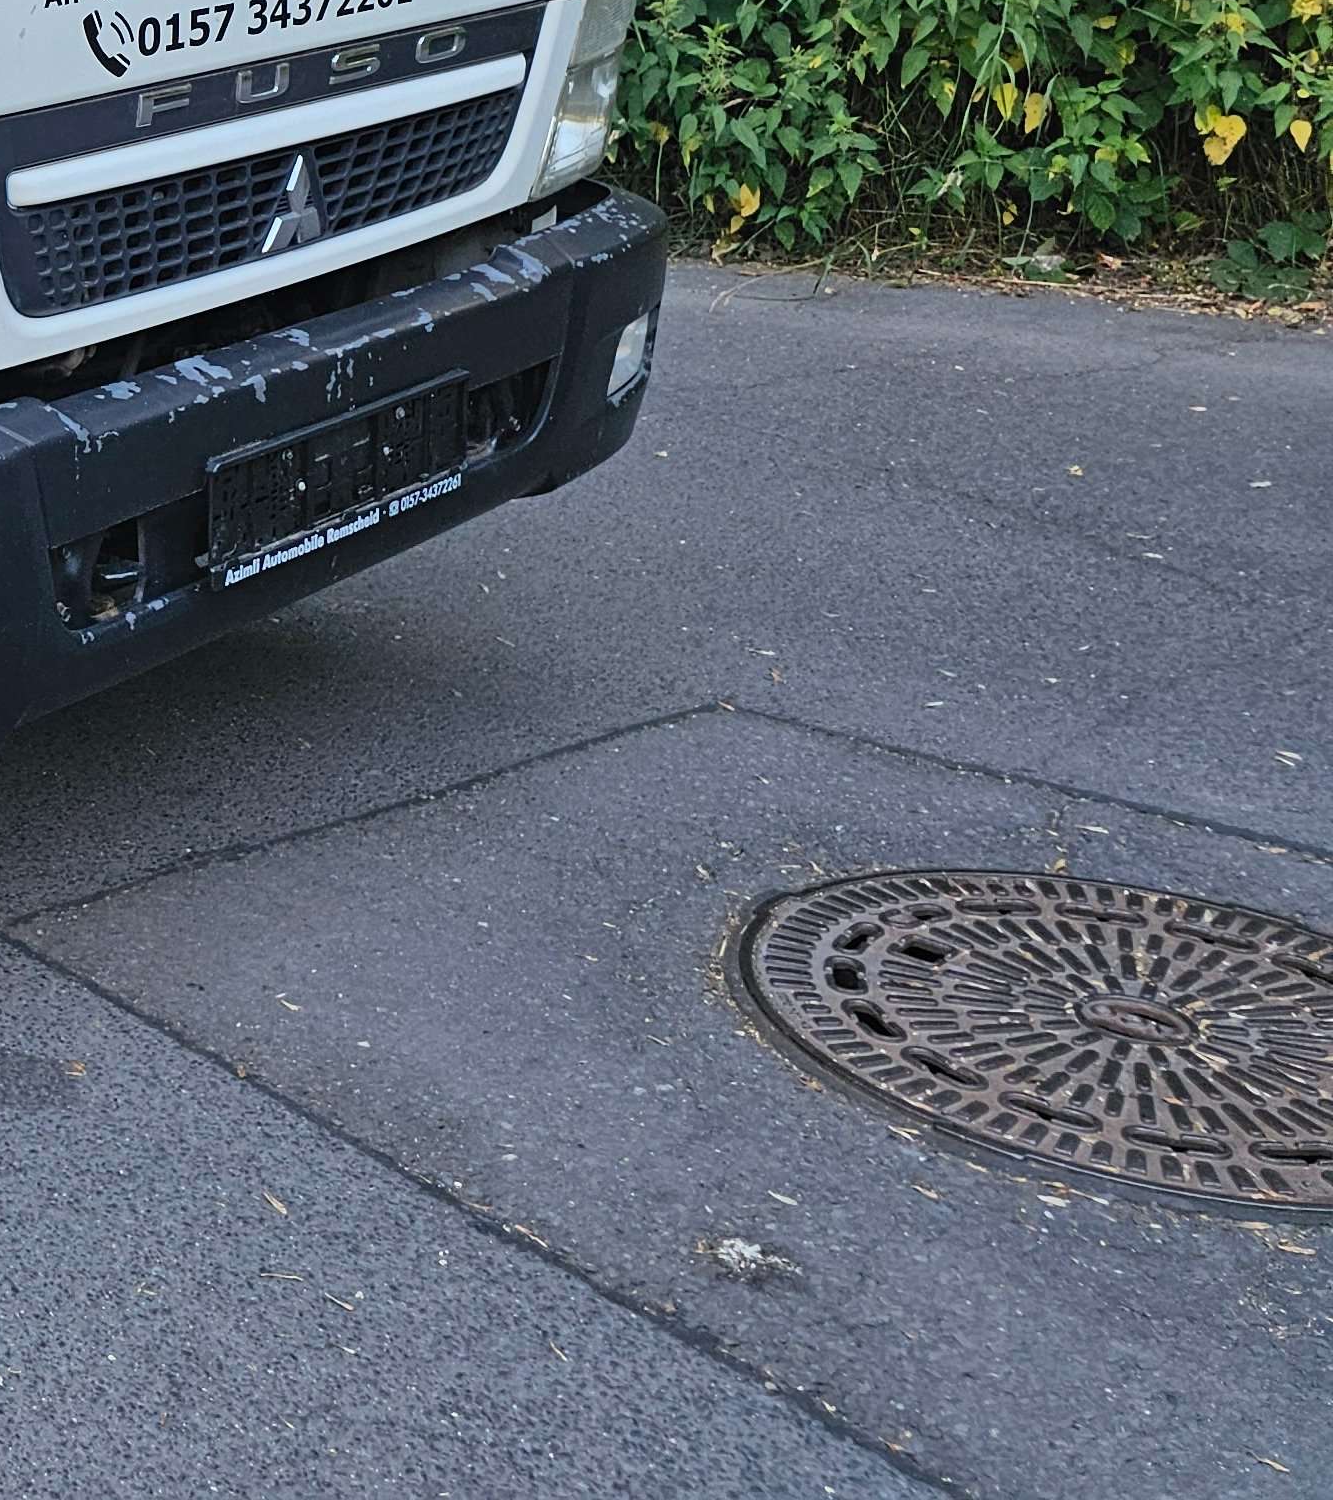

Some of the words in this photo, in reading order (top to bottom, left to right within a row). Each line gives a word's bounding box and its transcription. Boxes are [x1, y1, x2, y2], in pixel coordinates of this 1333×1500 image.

[136, 26, 466, 128] FUSO
[138, 2, 235, 56] 0157
[261, 534, 325, 571] Automobile
[326, 508, 380, 544] Remscheid
[400, 473, 462, 512] 0157-34372261
